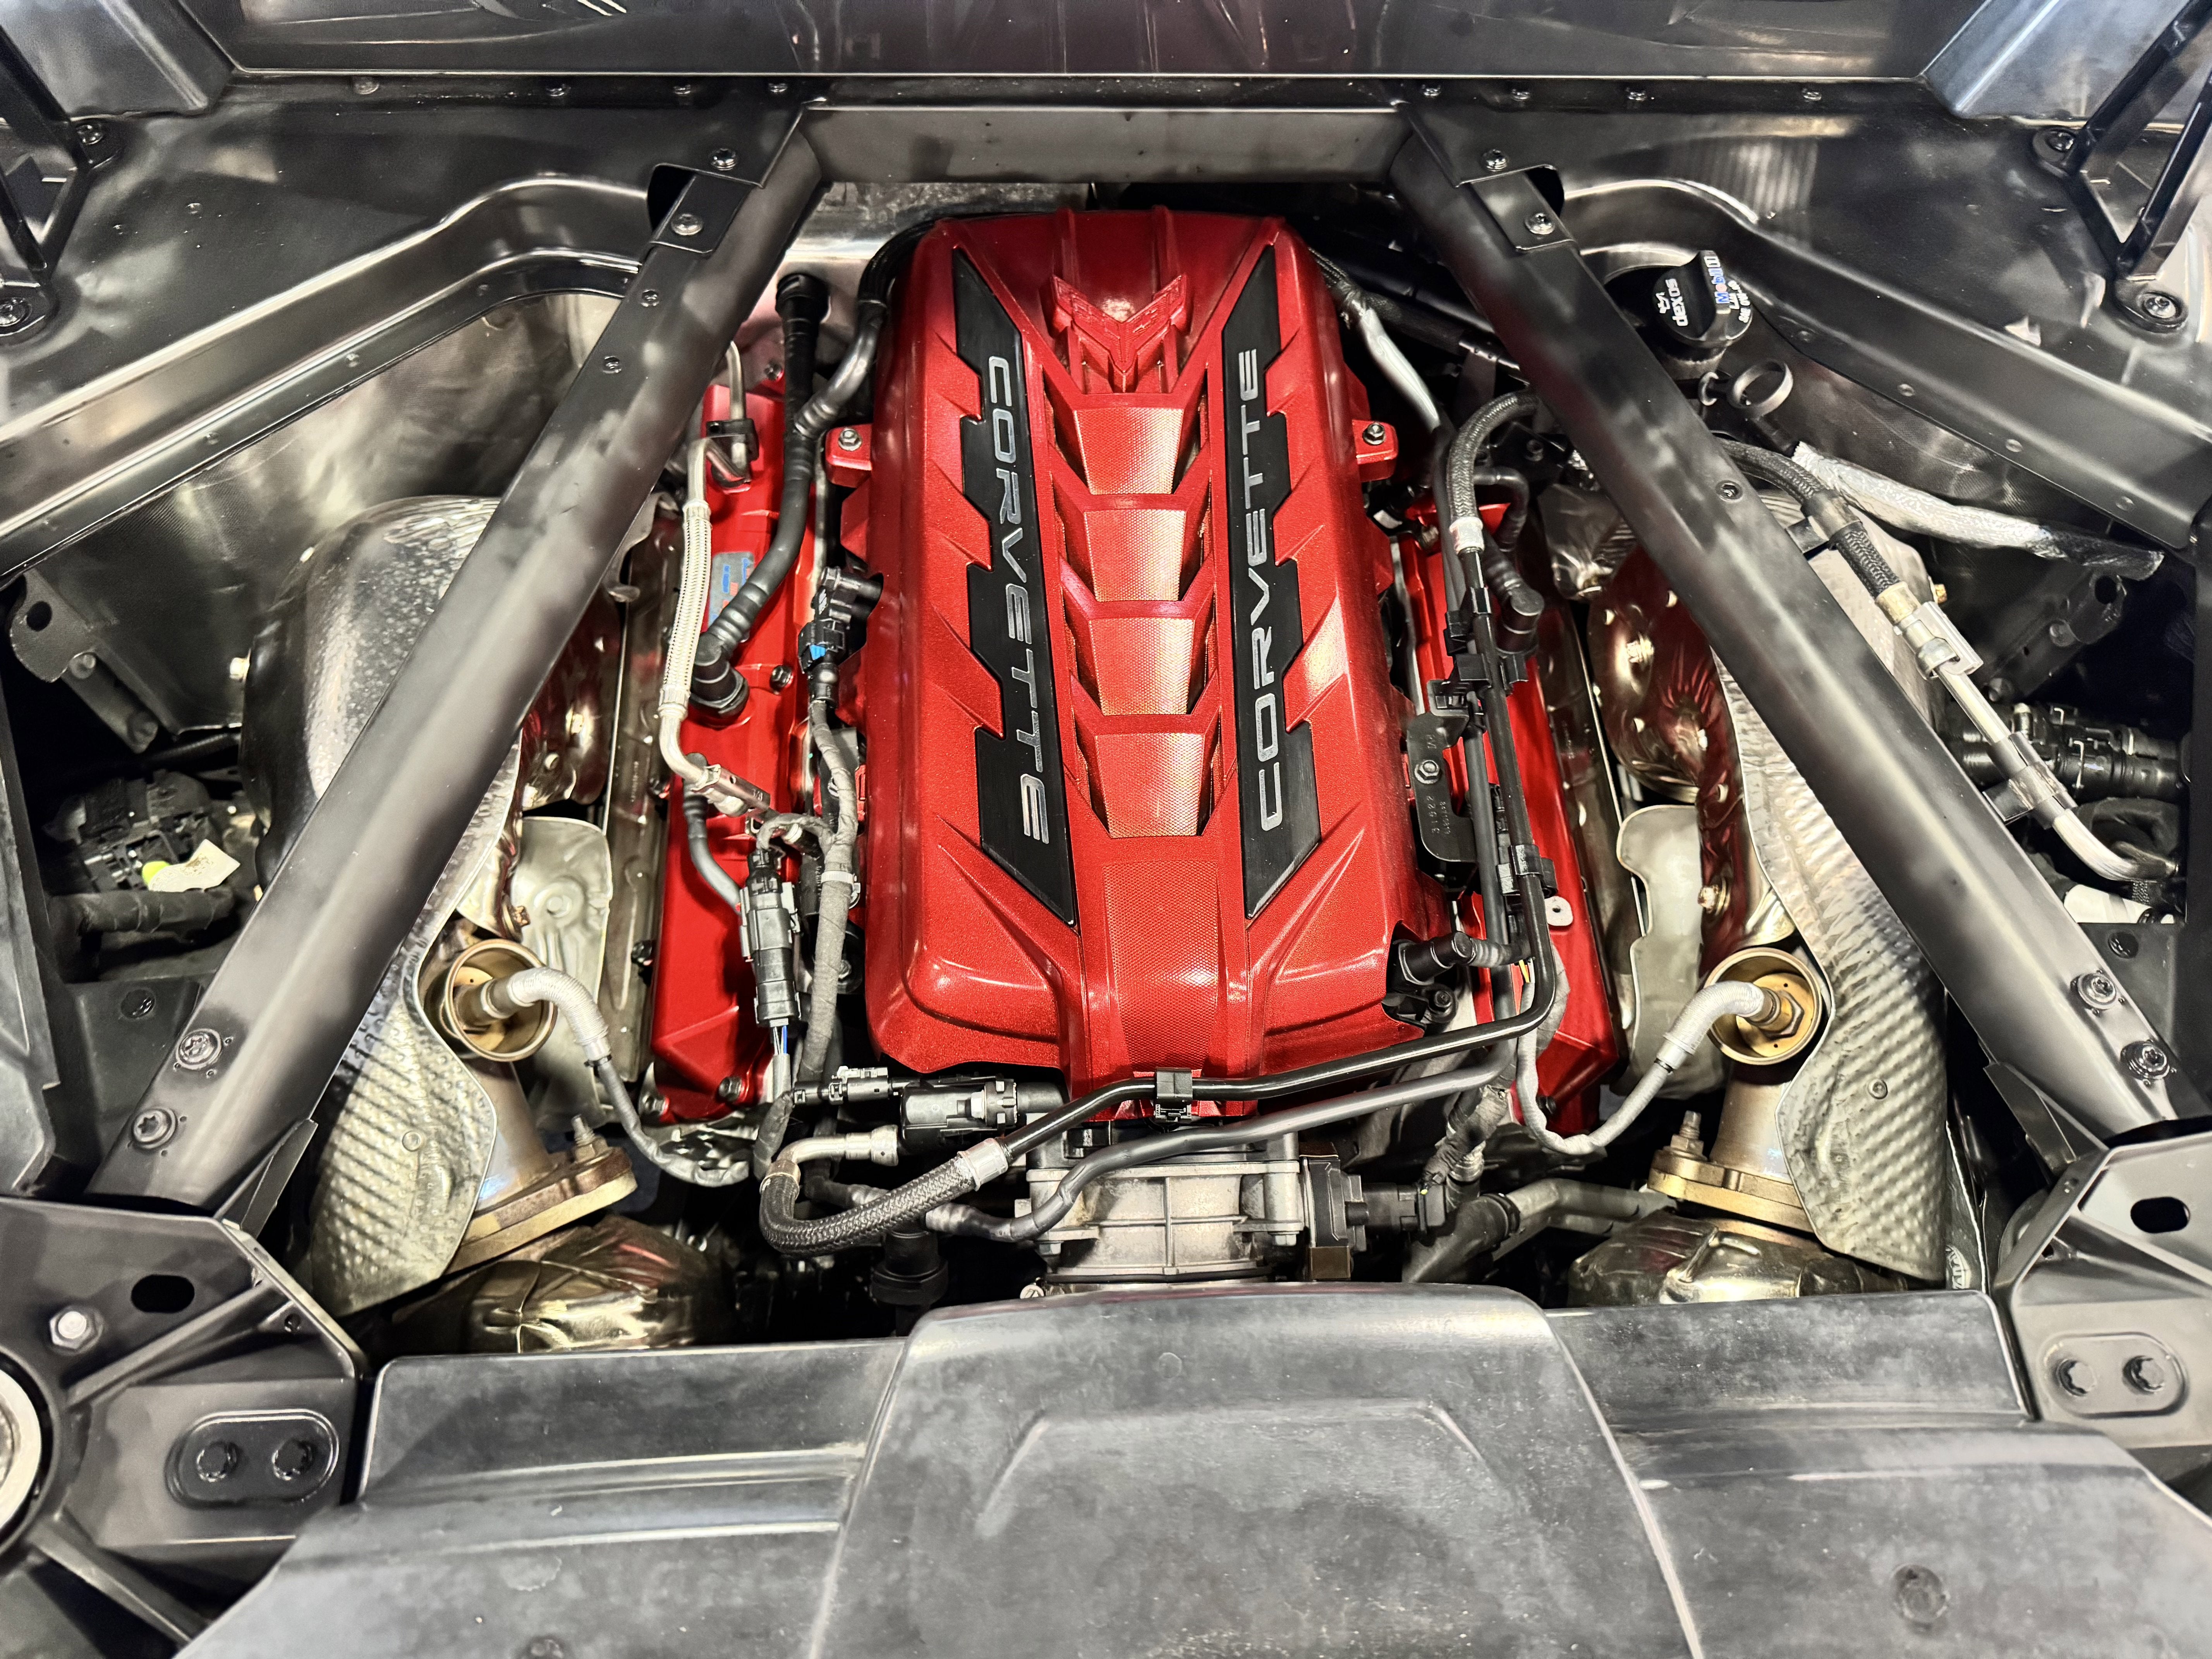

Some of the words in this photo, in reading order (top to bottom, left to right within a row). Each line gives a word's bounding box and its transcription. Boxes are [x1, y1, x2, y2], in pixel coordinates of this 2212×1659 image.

[1665, 278, 1688, 327] dexos
[1707, 267, 1730, 304] Mobil
[988, 356, 1049, 844] CORVETTE
[1238, 349, 1283, 832] CORVETTE
